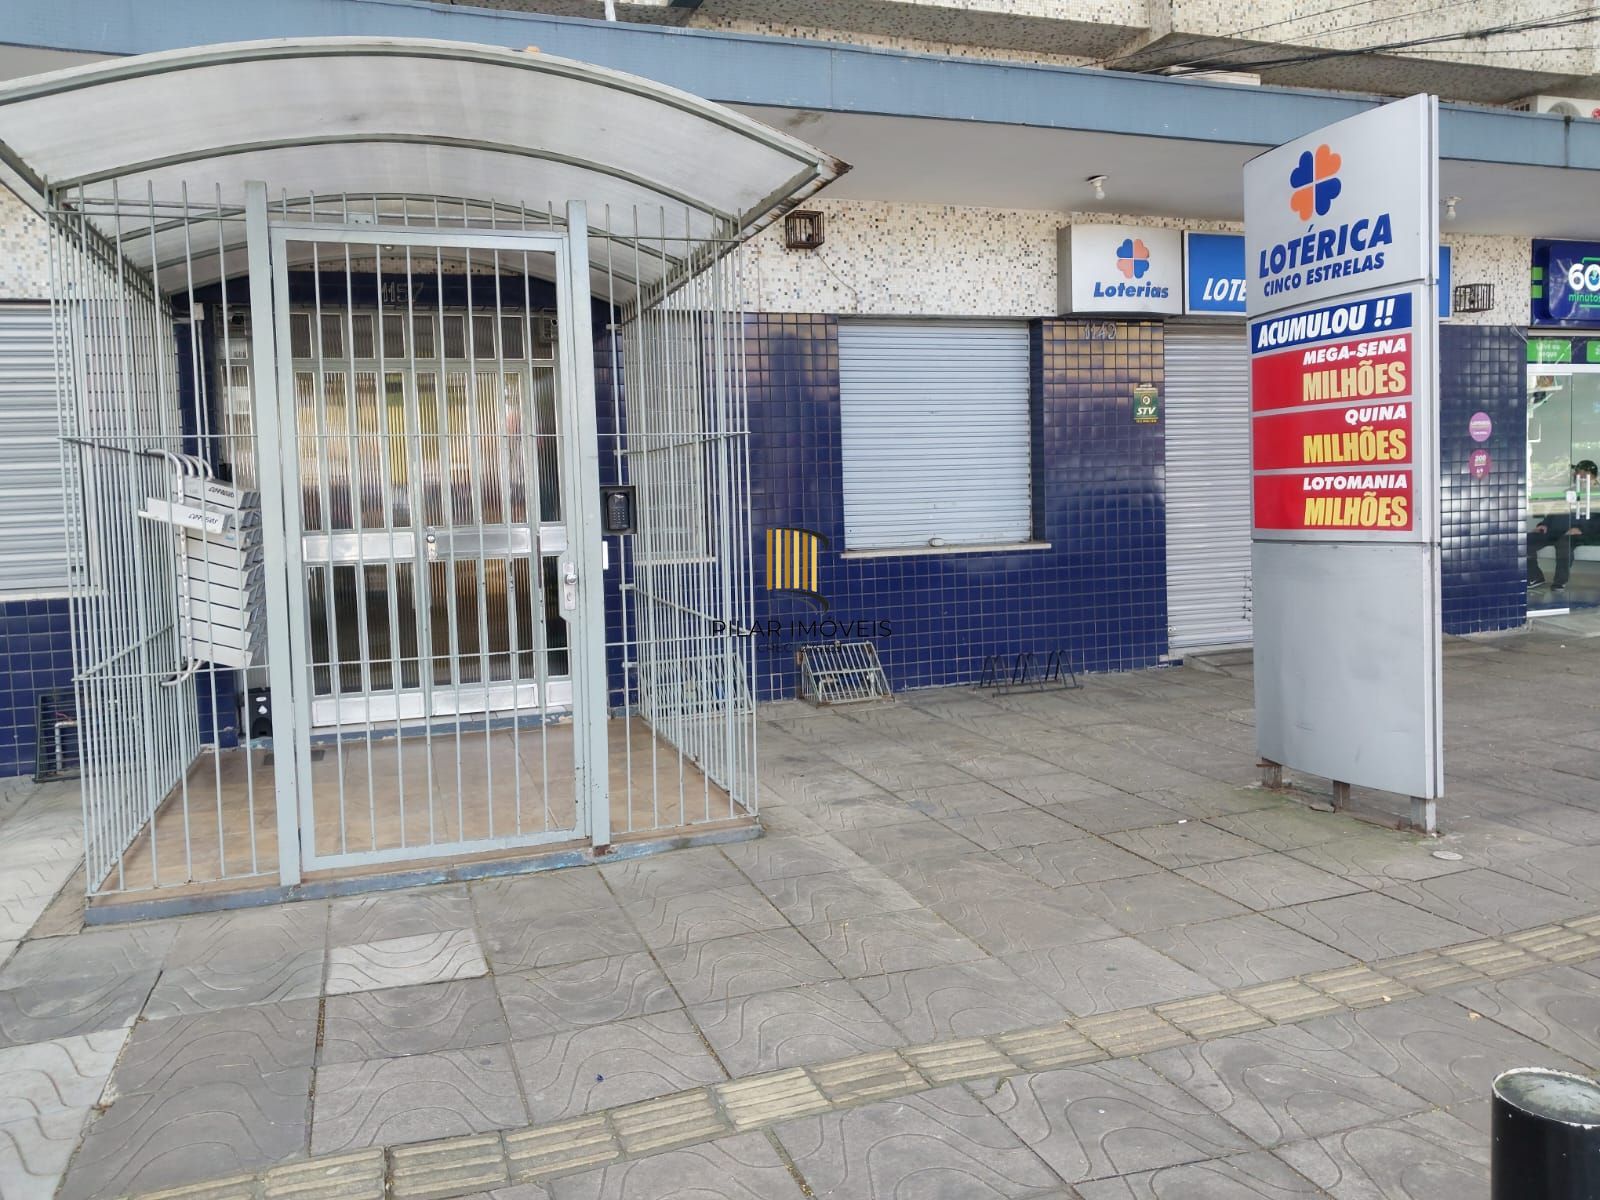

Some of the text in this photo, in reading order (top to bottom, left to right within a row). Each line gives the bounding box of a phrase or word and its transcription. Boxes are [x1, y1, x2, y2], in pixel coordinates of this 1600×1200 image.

[1259, 213, 1393, 279] LOTÉRICA
[1093, 281, 1169, 299] Loterias
[1264, 252, 1385, 297] CINCO ESTRELAS
[1568, 263, 1600, 292] 60
[1257, 298, 1396, 349] ACUMULOU !!
[1302, 337, 1407, 366] MEGA-SENA
[1303, 359, 1407, 402] MILHÕES
[1136, 407, 1157, 416] STV
[1345, 405, 1407, 426] QUINA
[1303, 425, 1407, 464] MILHÕES
[1303, 474, 1408, 490] LOTOMANIA
[1304, 491, 1408, 527] MILHÕES
